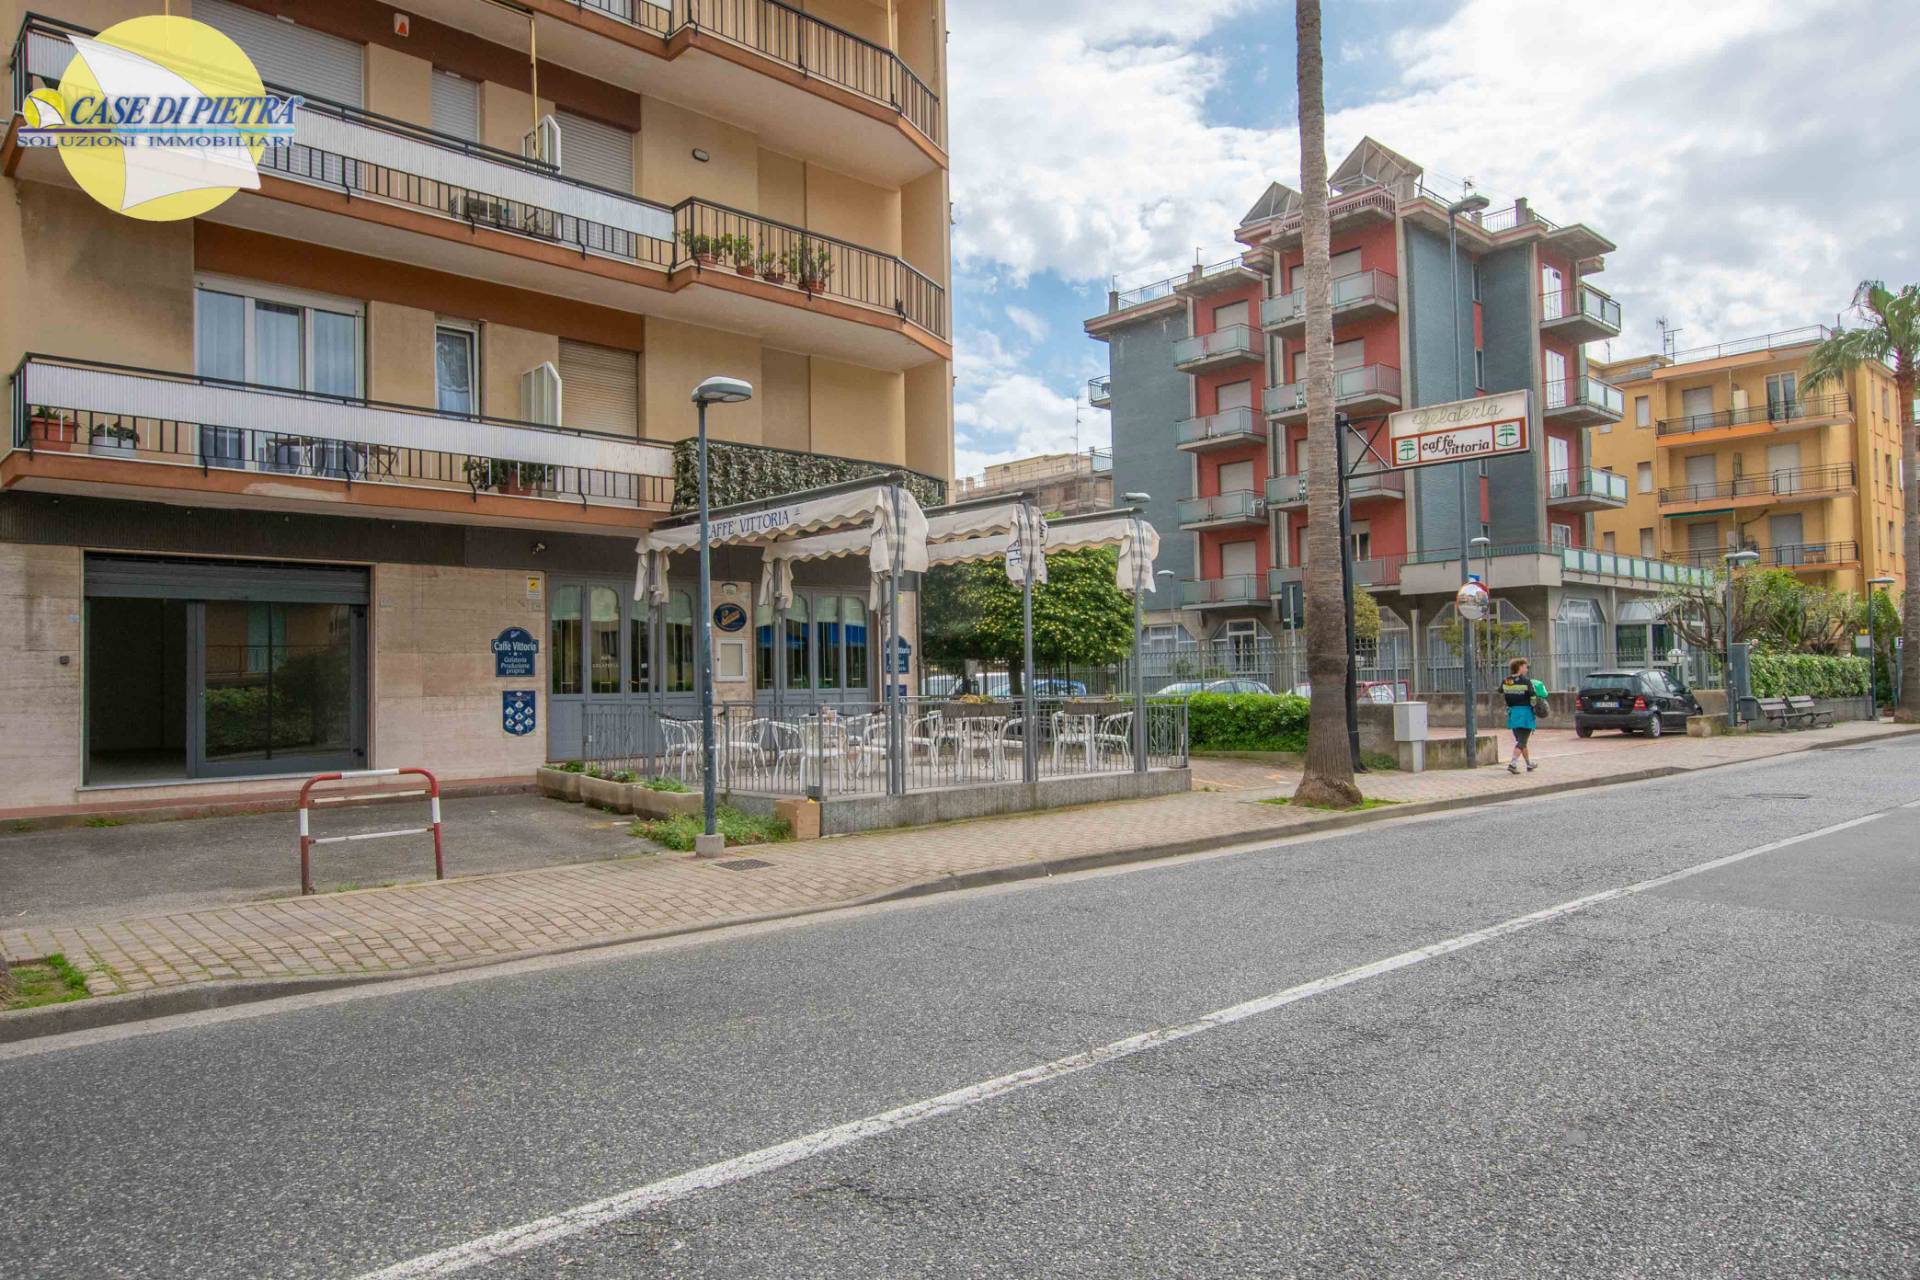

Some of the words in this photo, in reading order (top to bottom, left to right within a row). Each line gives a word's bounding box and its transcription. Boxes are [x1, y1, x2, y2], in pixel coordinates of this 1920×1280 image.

[1444, 440, 1490, 455] vittoria
[739, 510, 790, 533] VITTORIA
[512, 641, 537, 652] Vittoria
